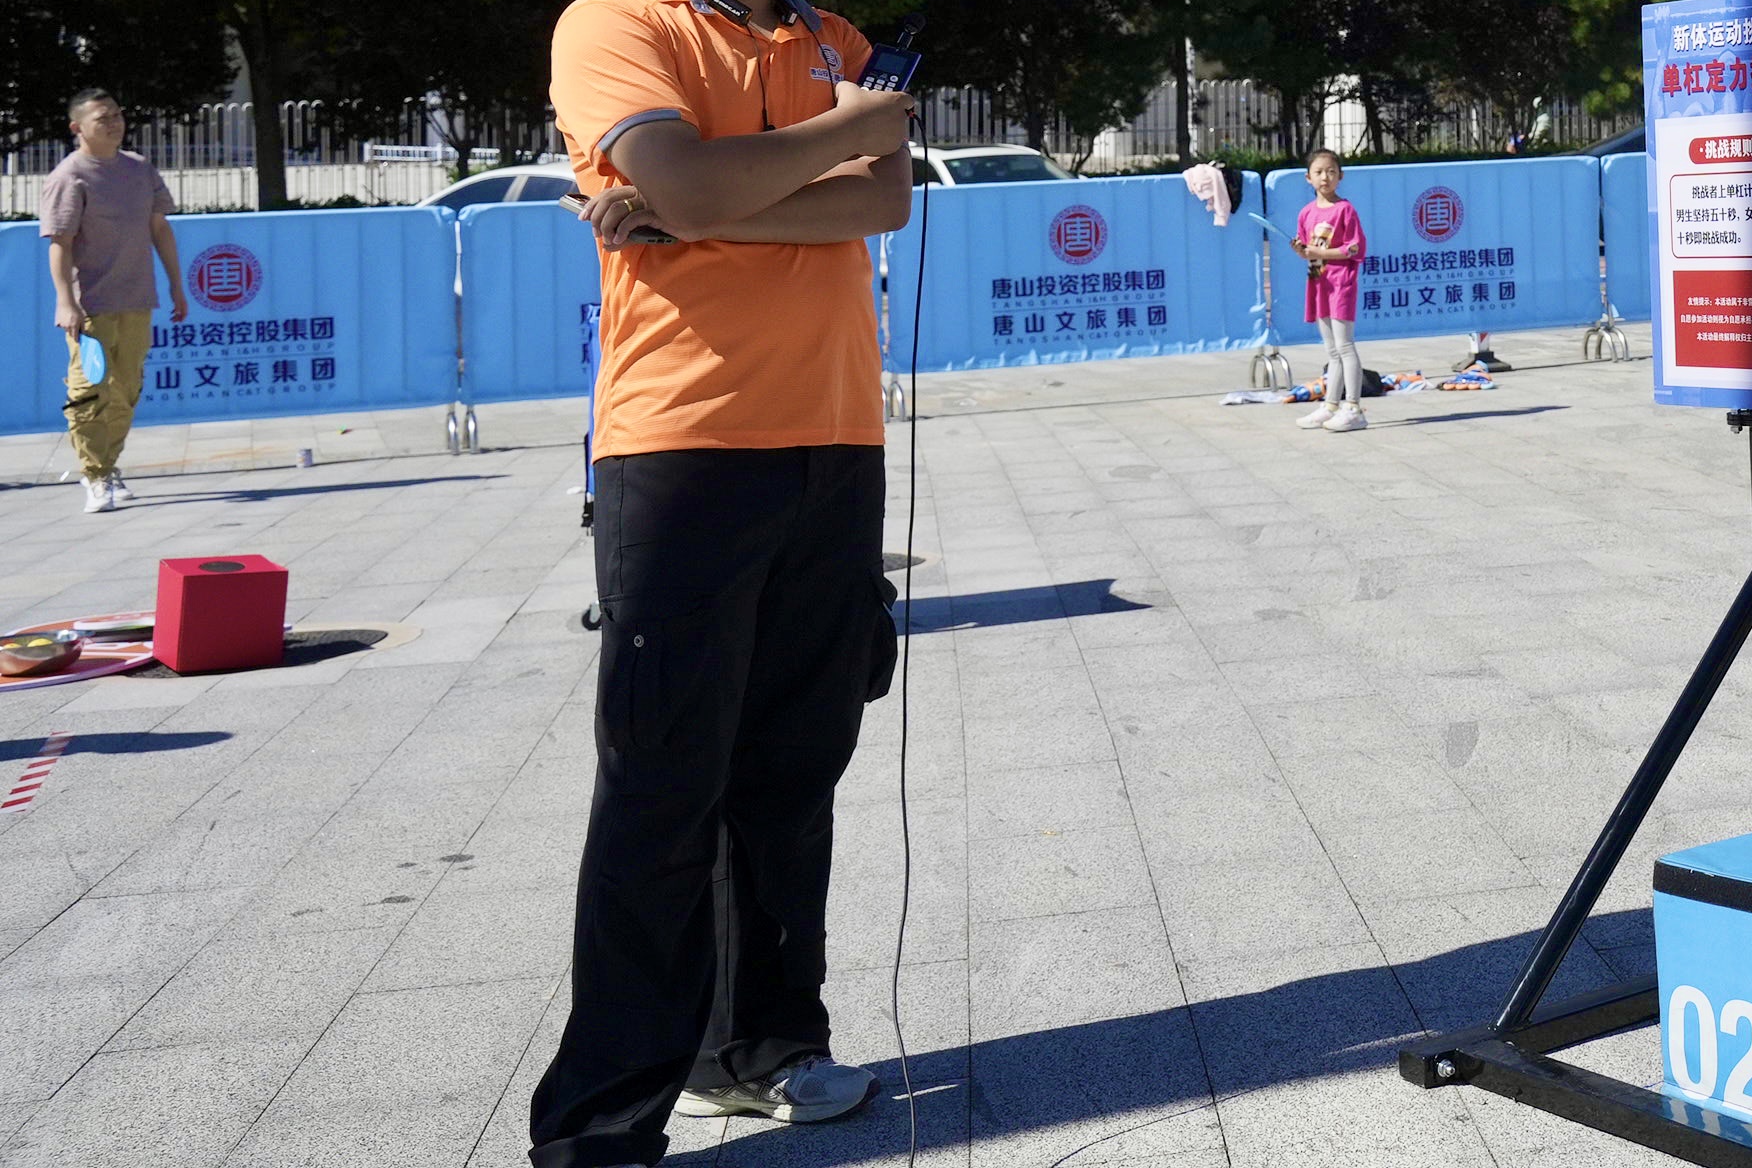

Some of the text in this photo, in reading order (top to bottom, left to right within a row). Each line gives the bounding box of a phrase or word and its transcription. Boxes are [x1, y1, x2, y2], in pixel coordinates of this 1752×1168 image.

[1677, 231, 1742, 246] 十秒即挑战成功。
[1362, 247, 1514, 276] 唐山投资控股集团
[992, 269, 1165, 299] 唐山投资控股集团
[1362, 281, 1516, 310] 唐山文旅集团
[993, 305, 1167, 336] 唐山文旅集团
[141, 357, 335, 390] 山文旅集团
